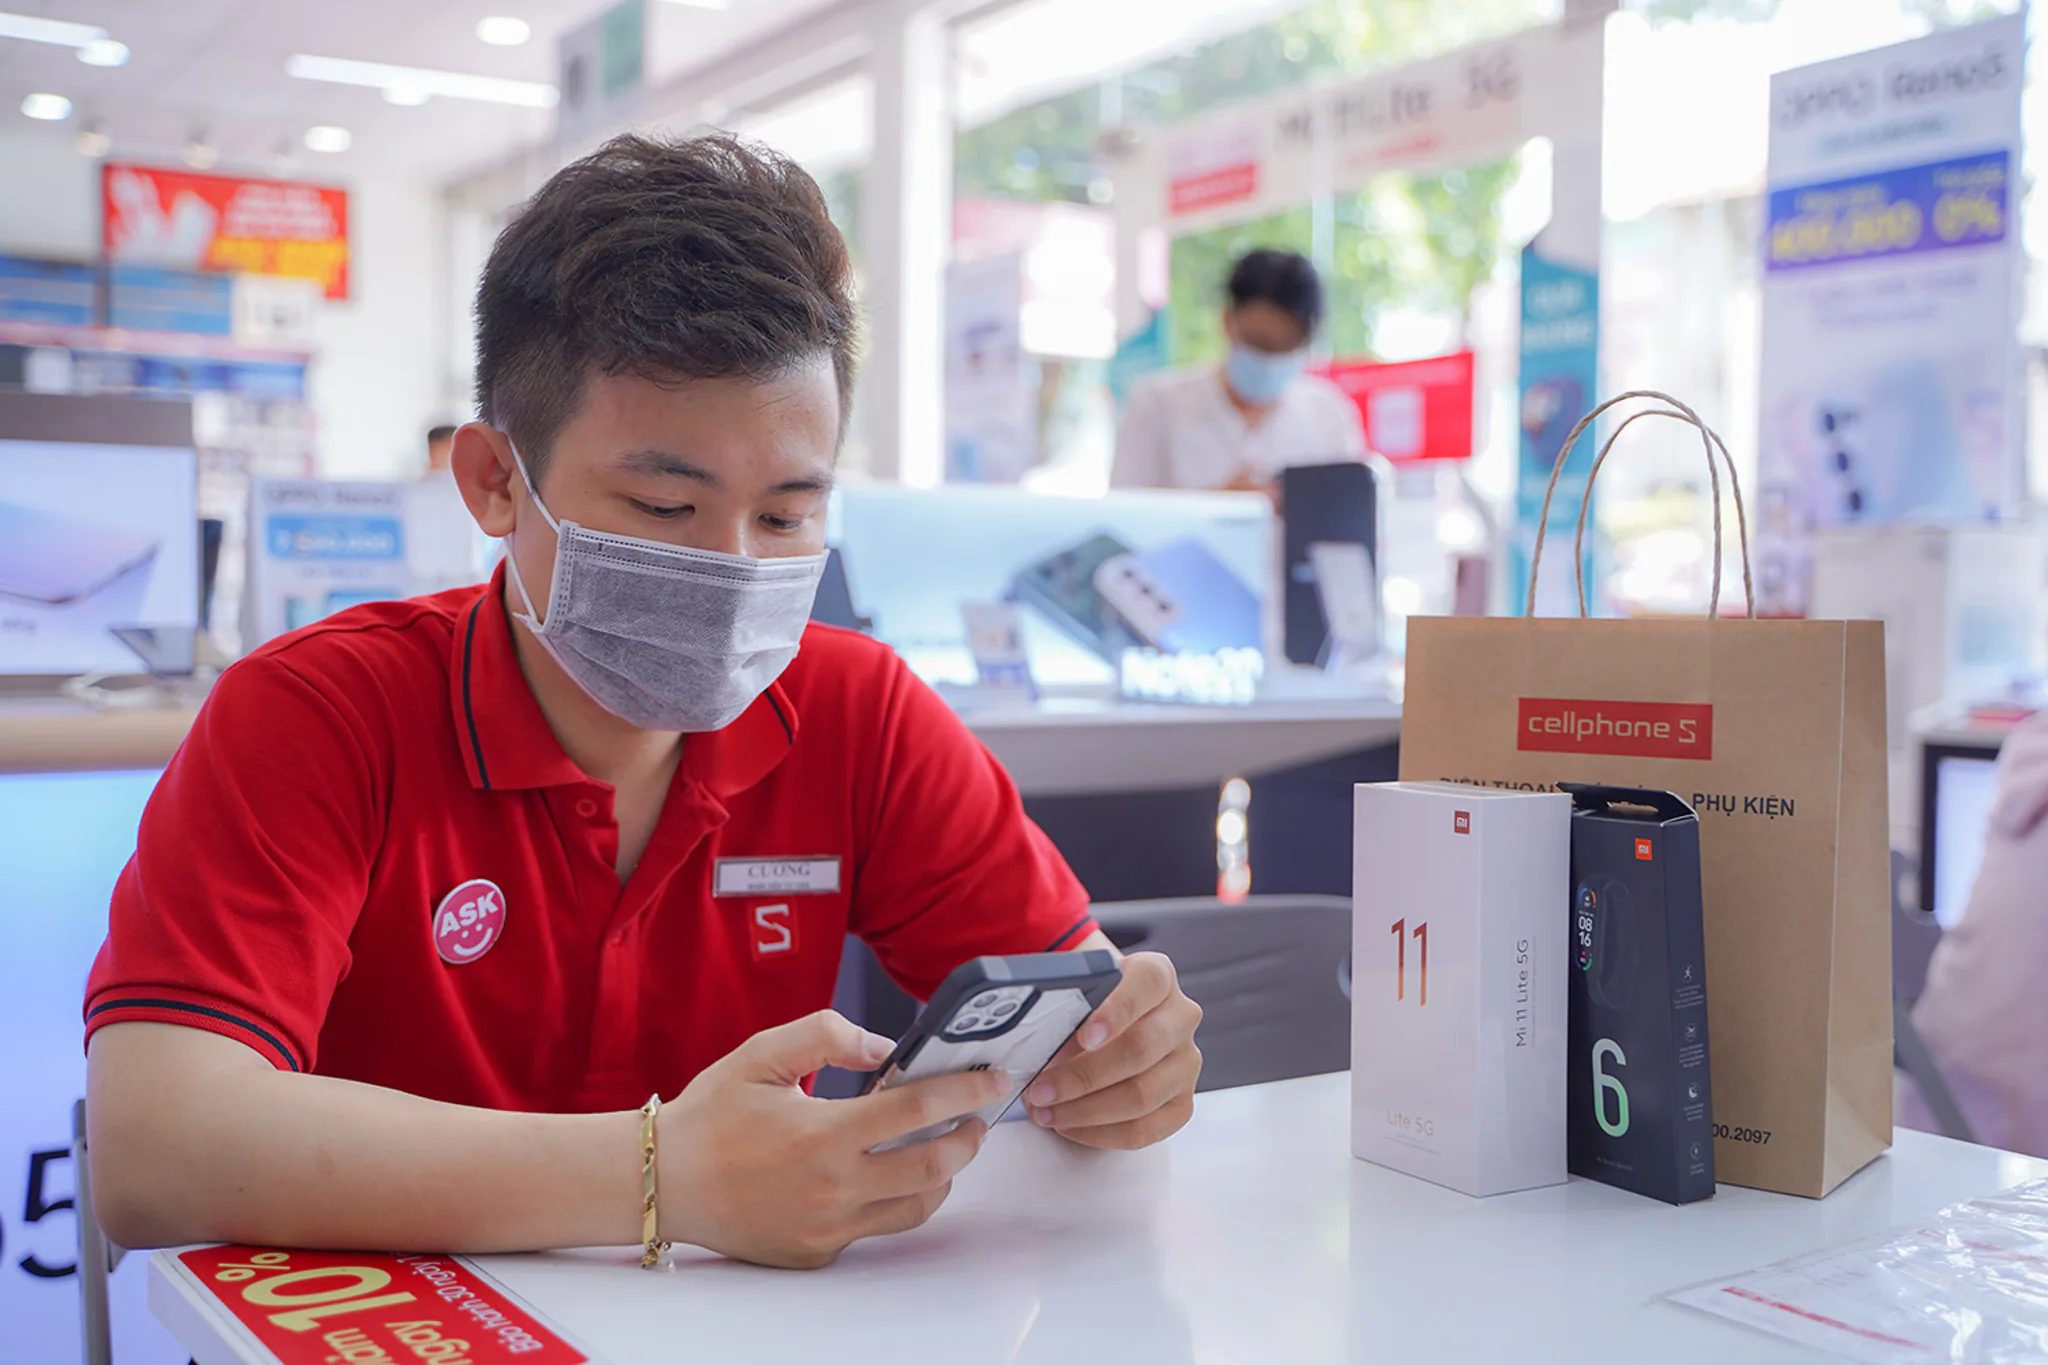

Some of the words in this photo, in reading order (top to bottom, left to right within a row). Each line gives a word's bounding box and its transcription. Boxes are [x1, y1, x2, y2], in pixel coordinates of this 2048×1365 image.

[1529, 711, 1670, 741] cellphone
[1692, 793, 1736, 817] PHỤ
[1743, 794, 1795, 820] KIỆN
[440, 890, 498, 937] ASK
[1578, 916, 1593, 932] 08
[1516, 939, 1529, 964] 5G
[1578, 932, 1592, 947] 16
[1391, 917, 1427, 1006] 11
[1515, 971, 1529, 1003] Lite
[1516, 1008, 1527, 1022] 11
[1515, 1026, 1527, 1047] Mi
[1591, 1038, 1630, 1138] 6
[1387, 1107, 1411, 1130] Lite
[1415, 1116, 1434, 1137] 5G
[410, 1261, 458, 1286] ngày
[215, 1253, 417, 1333] 10%
[437, 1285, 475, 1303] 30
[458, 1298, 512, 1329] hành
[498, 1326, 544, 1354] Bảo
